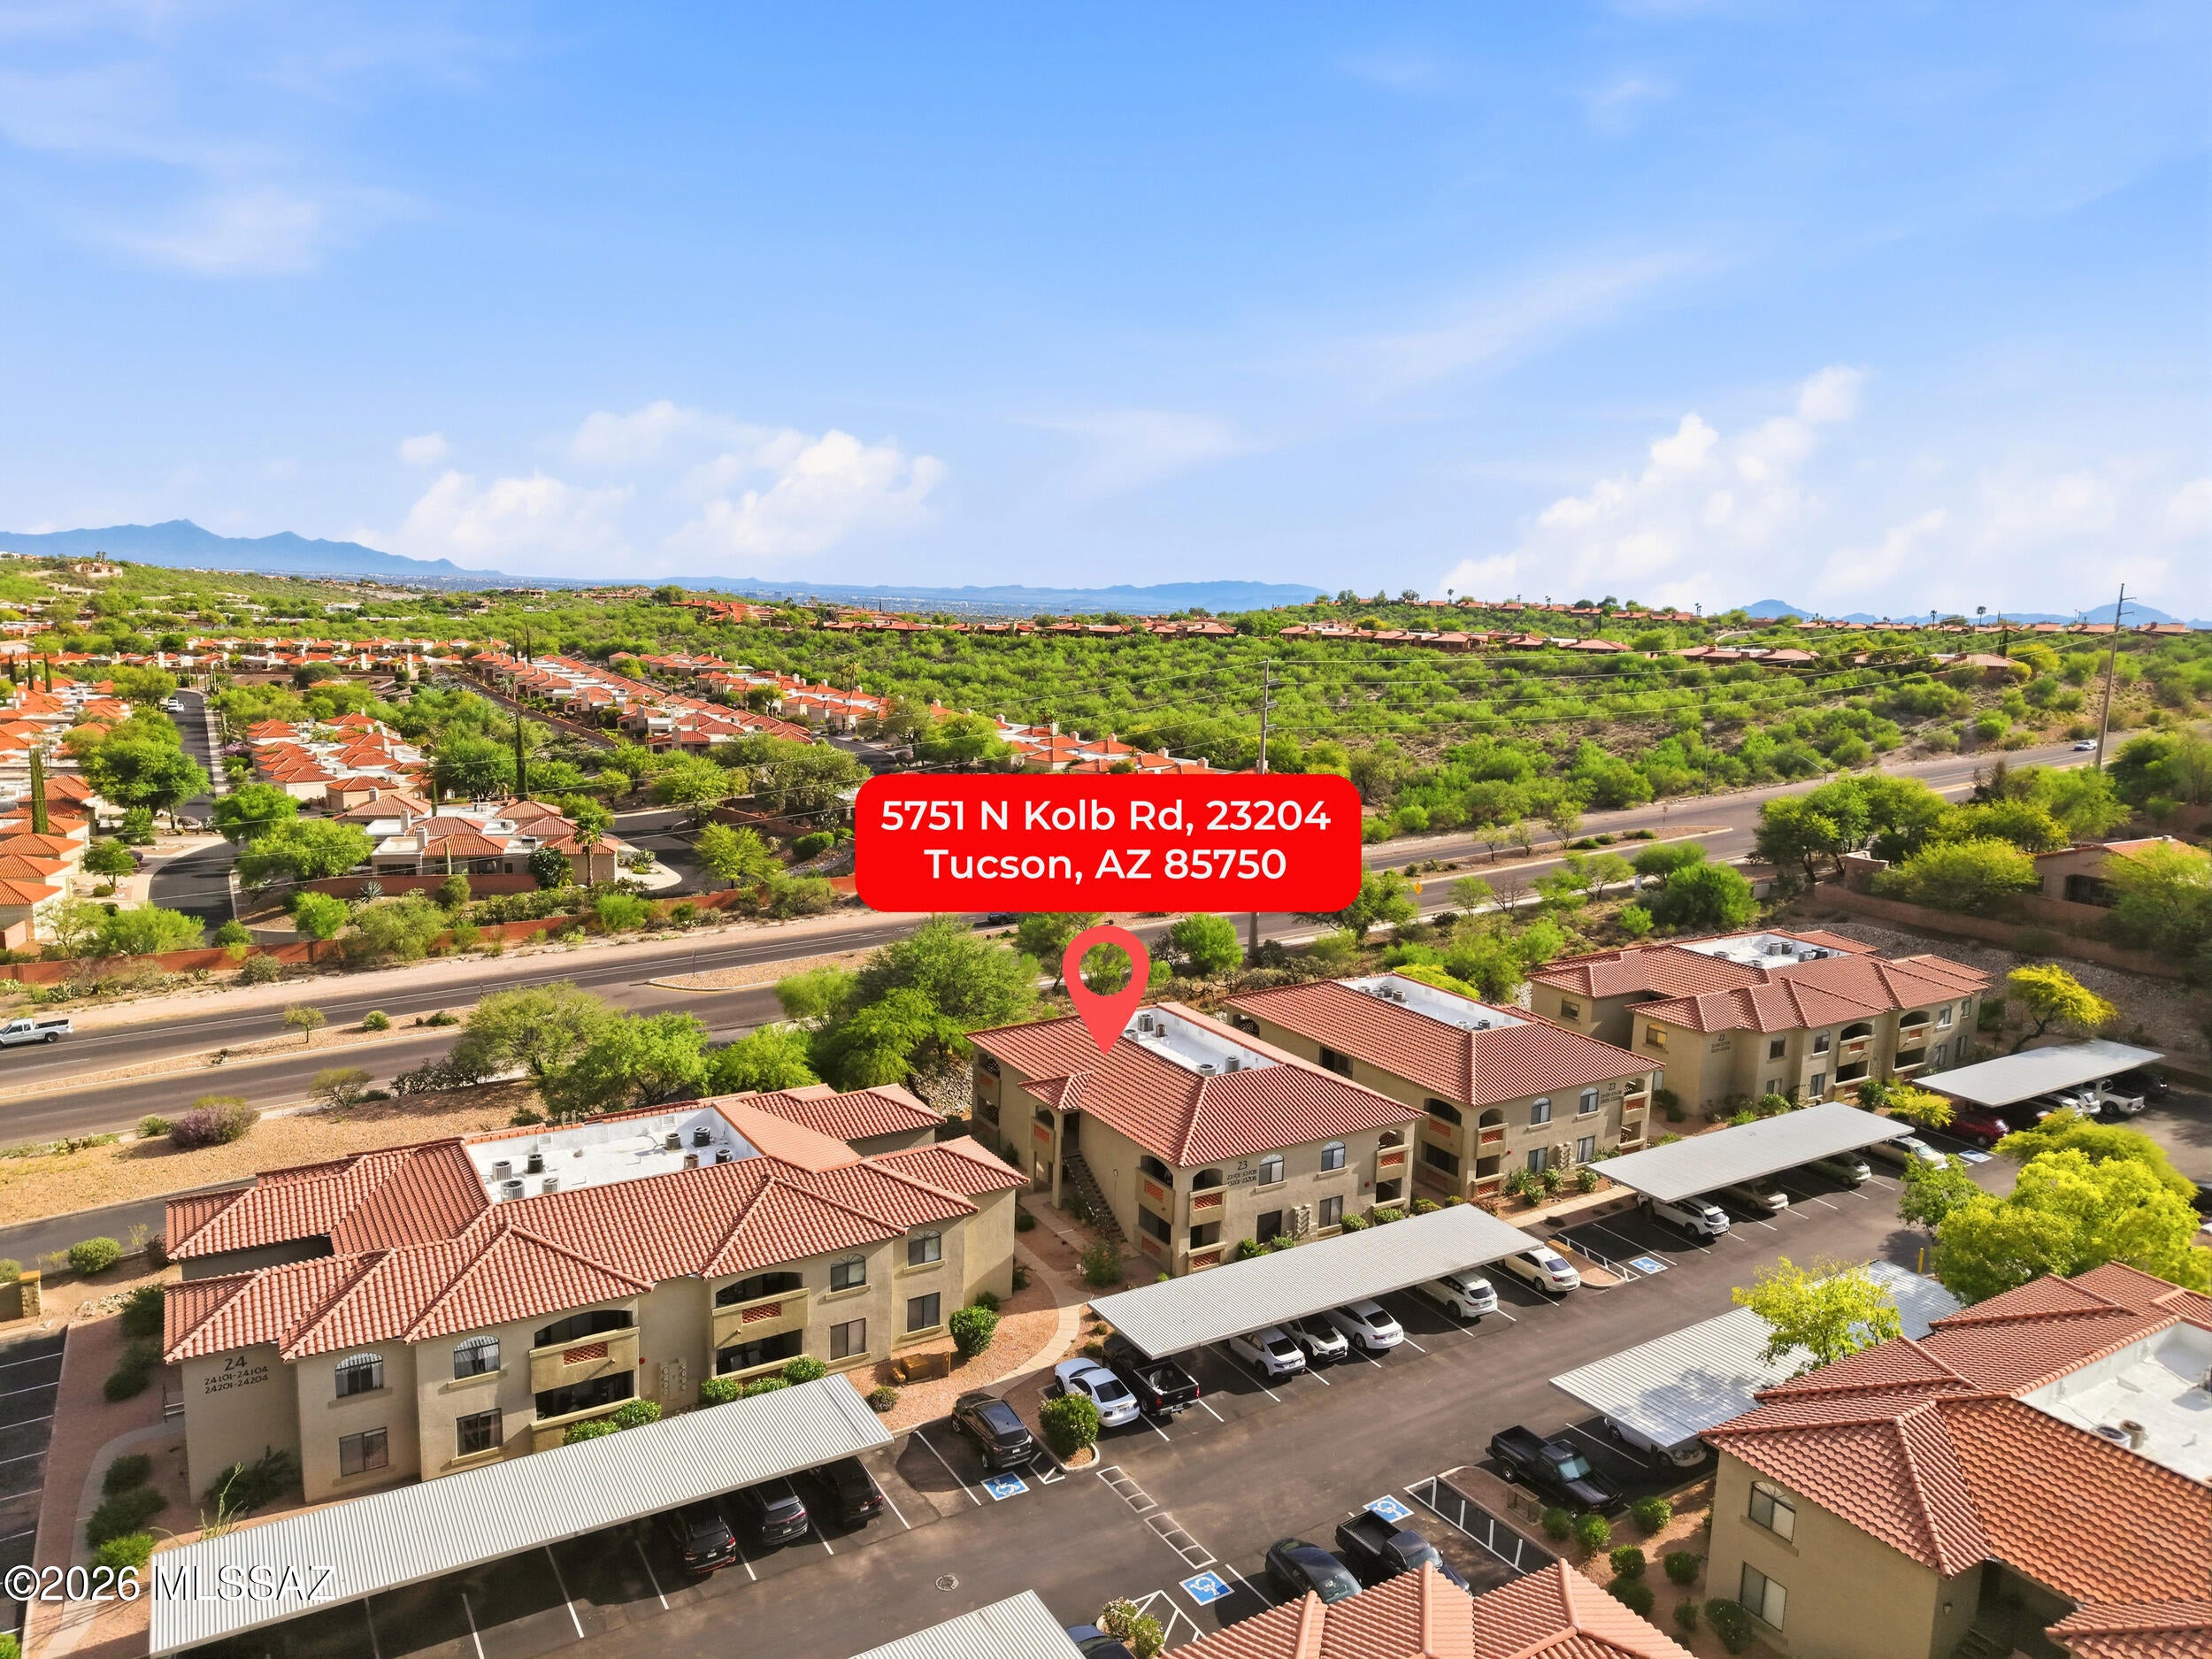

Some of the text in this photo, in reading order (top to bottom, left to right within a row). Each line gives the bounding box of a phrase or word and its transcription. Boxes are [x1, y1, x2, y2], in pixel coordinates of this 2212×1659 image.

[1237, 1160, 1248, 1171] 23
[224, 1355, 248, 1371] 24
[204, 1365, 269, 1386] 24101-24104
[204, 1374, 269, 1394] 24201-24204
